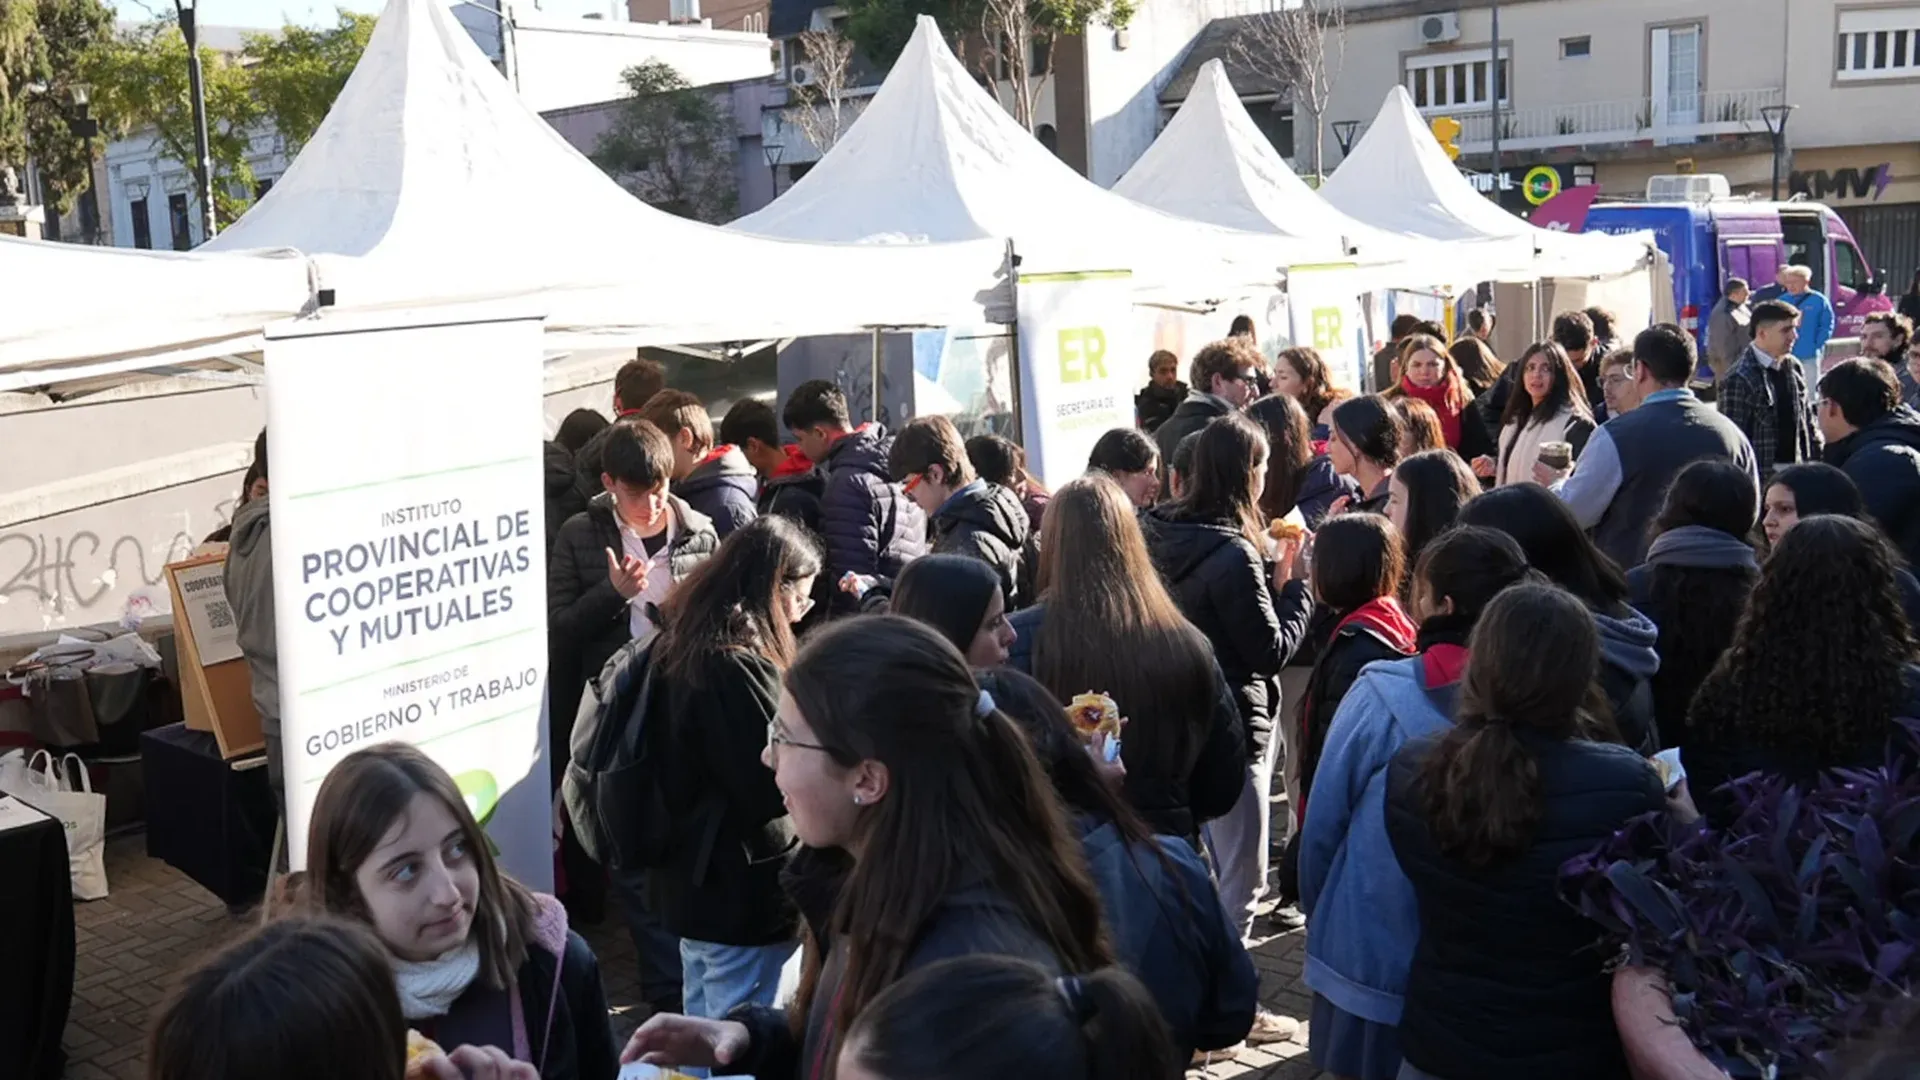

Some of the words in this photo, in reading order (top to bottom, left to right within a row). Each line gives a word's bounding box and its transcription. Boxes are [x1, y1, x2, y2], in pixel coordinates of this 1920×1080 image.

[1788, 164, 1879, 200] KMV
[1057, 325, 1109, 384] ER
[1311, 306, 1343, 349] ER
[381, 498, 462, 527] INSTITUTO
[302, 520, 488, 584] PROVINCIAL
[497, 510, 530, 541] DE
[305, 546, 530, 623] COOPERATIVAS
[329, 625, 350, 655] Y
[360, 586, 513, 649] MUTUALES
[306, 703, 422, 756] GOBIERNO
[428, 696, 441, 716] Y
[448, 667, 538, 710] TRABAJO
[383, 671, 451, 699] MINISTERIO
[454, 665, 469, 681] DE
